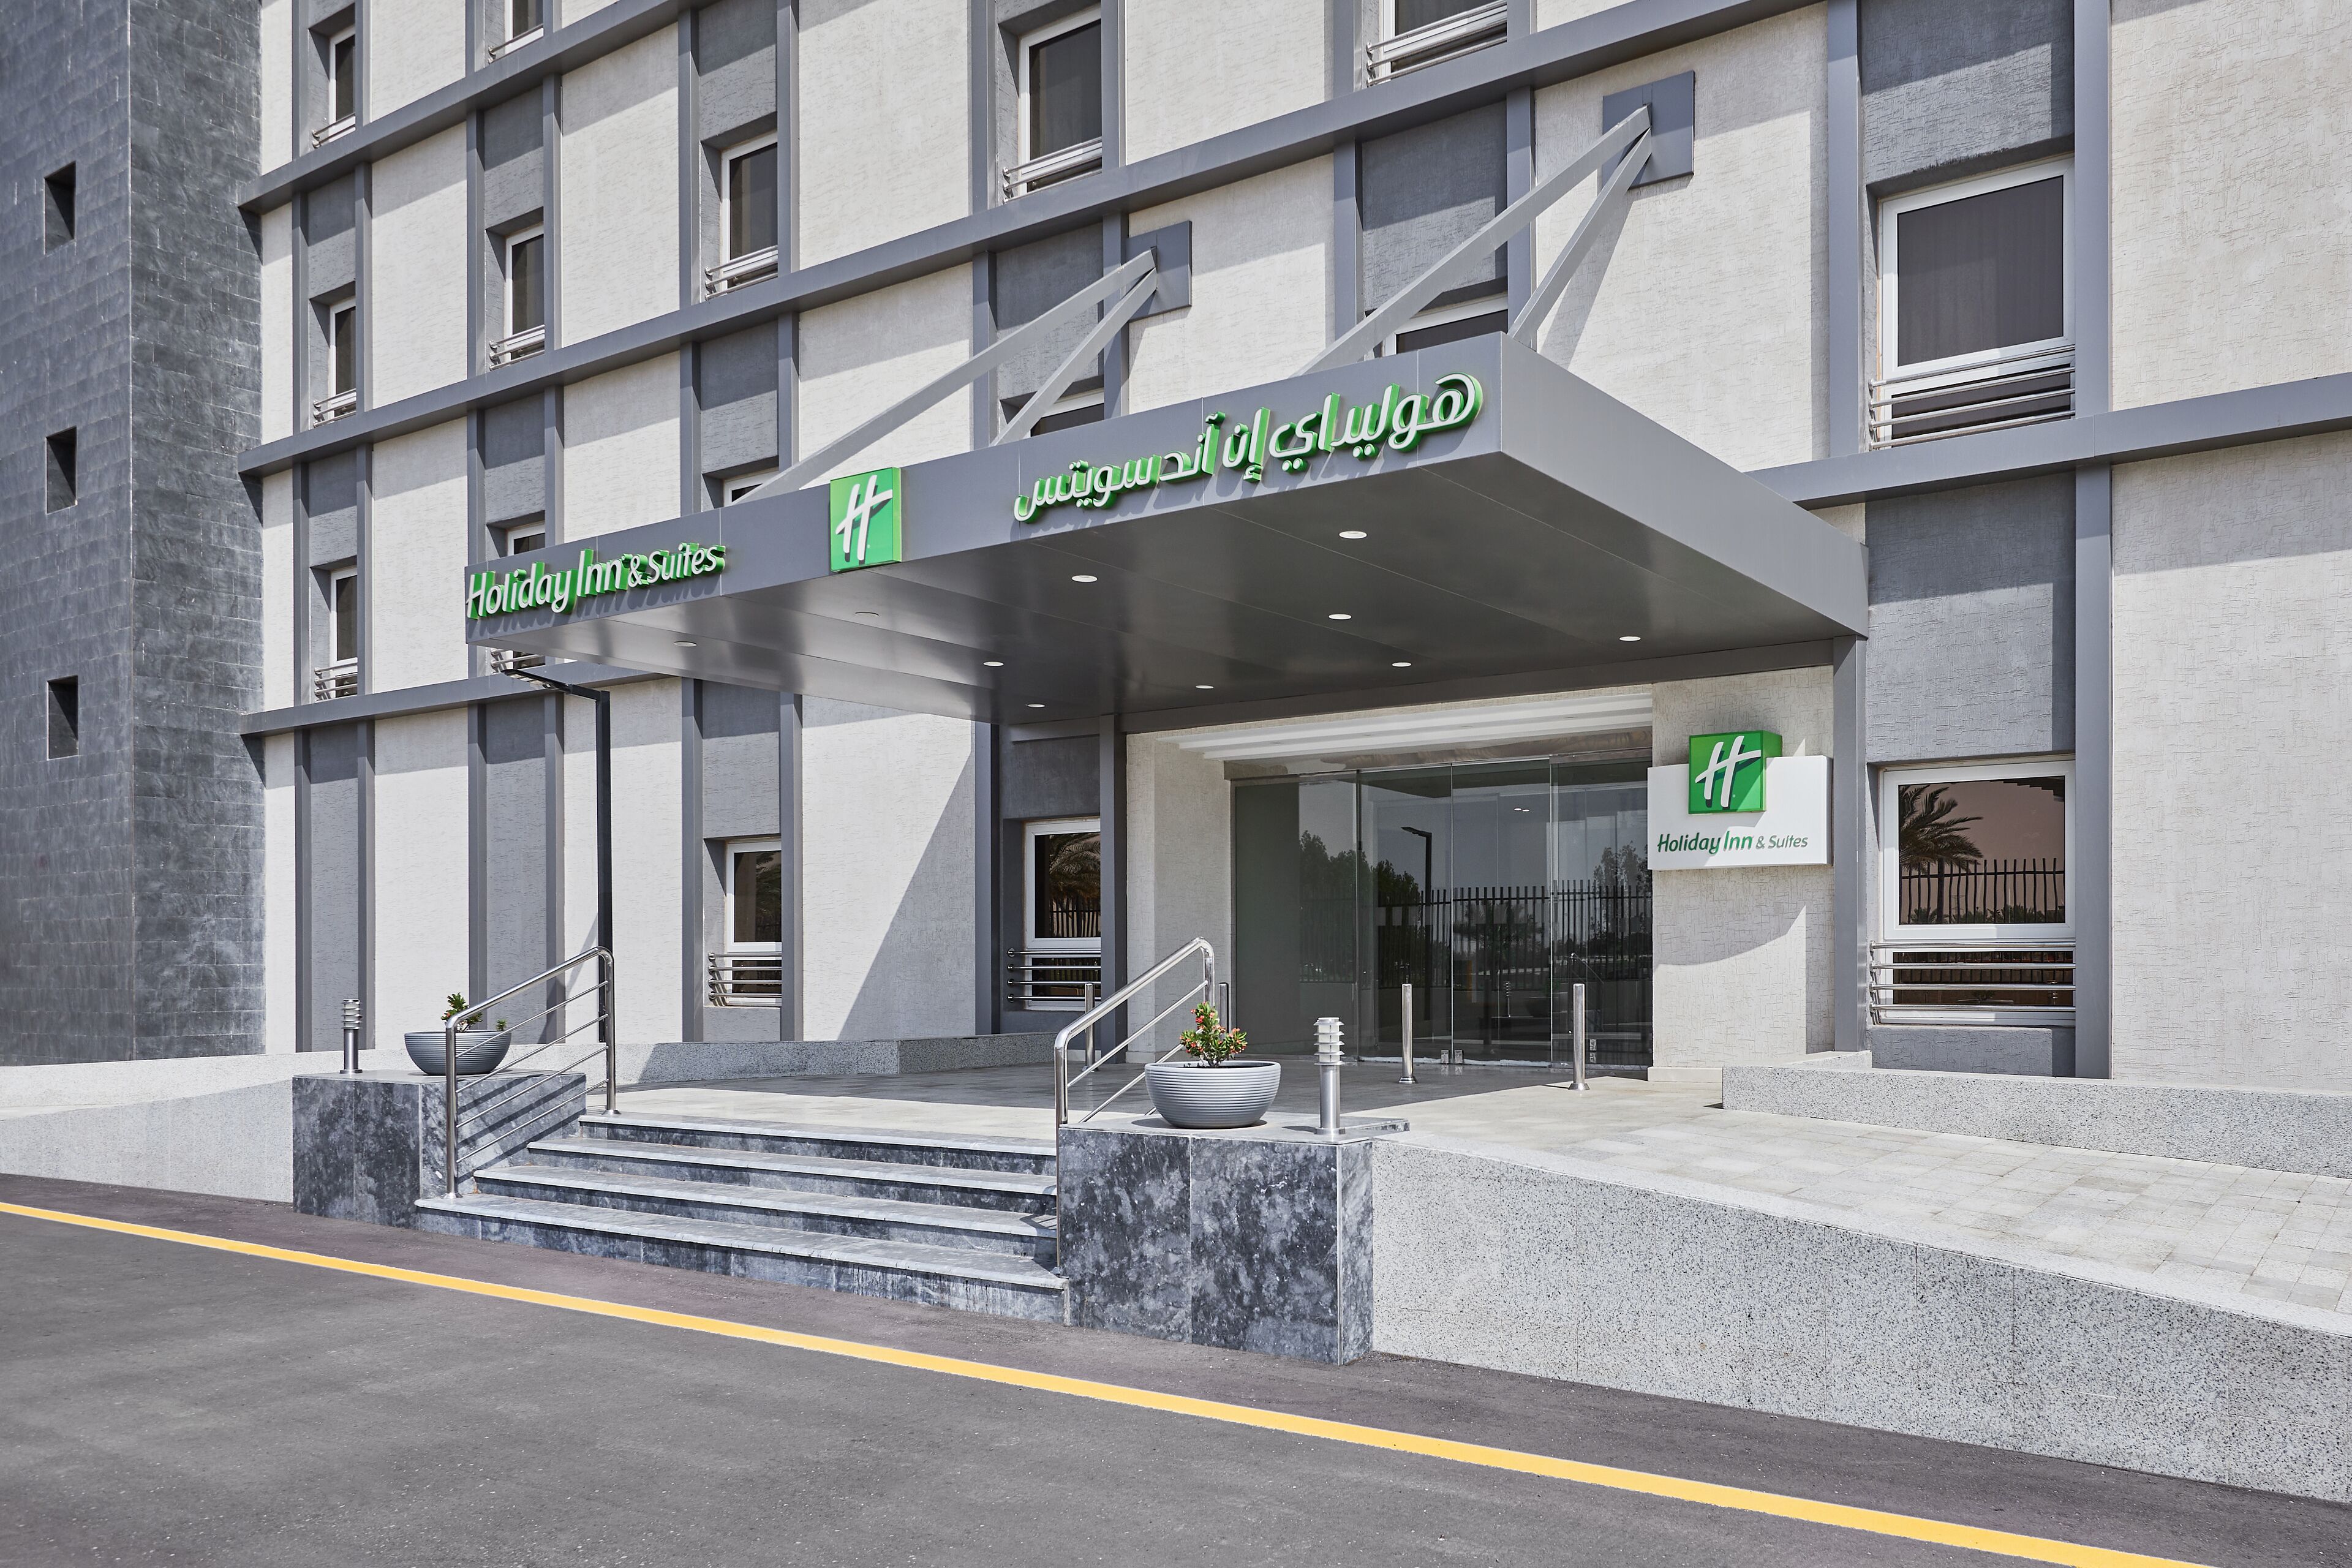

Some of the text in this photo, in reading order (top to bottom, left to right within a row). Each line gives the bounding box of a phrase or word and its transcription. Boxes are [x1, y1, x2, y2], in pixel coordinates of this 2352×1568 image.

[1223, 407, 1270, 481] إن
[1268, 372, 1482, 473] هوليداي
[835, 474, 893, 561] H
[1014, 455, 1162, 523] سويتس
[466, 542, 726, 619] Holiday Inn & Suites
[1695, 735, 1762, 807] H
[1657, 830, 1809, 855] Holiday Inn & Suites
